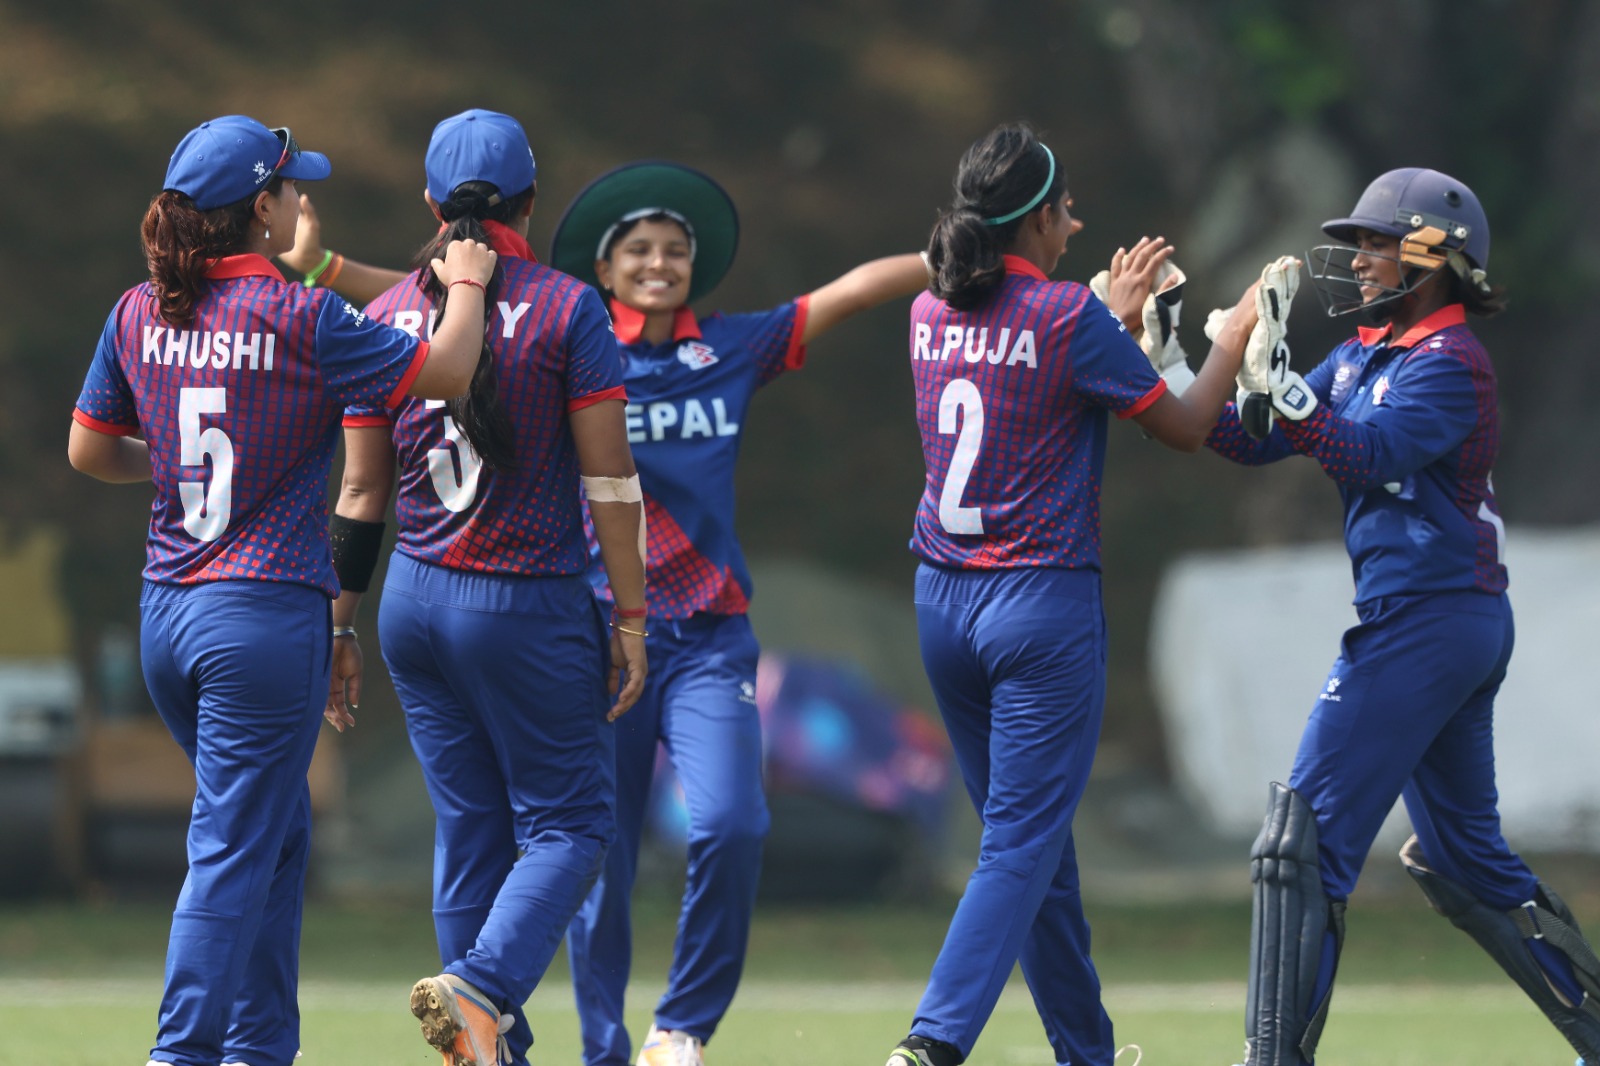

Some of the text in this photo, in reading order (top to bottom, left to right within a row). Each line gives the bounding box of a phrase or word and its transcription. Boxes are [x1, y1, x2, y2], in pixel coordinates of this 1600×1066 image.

[394, 301, 532, 344] RY
[913, 322, 1038, 369] R.PUJA
[142, 325, 276, 371] KHUSHI
[624, 397, 739, 443] EPAL
[178, 387, 234, 542] 5
[938, 378, 985, 535] 2
